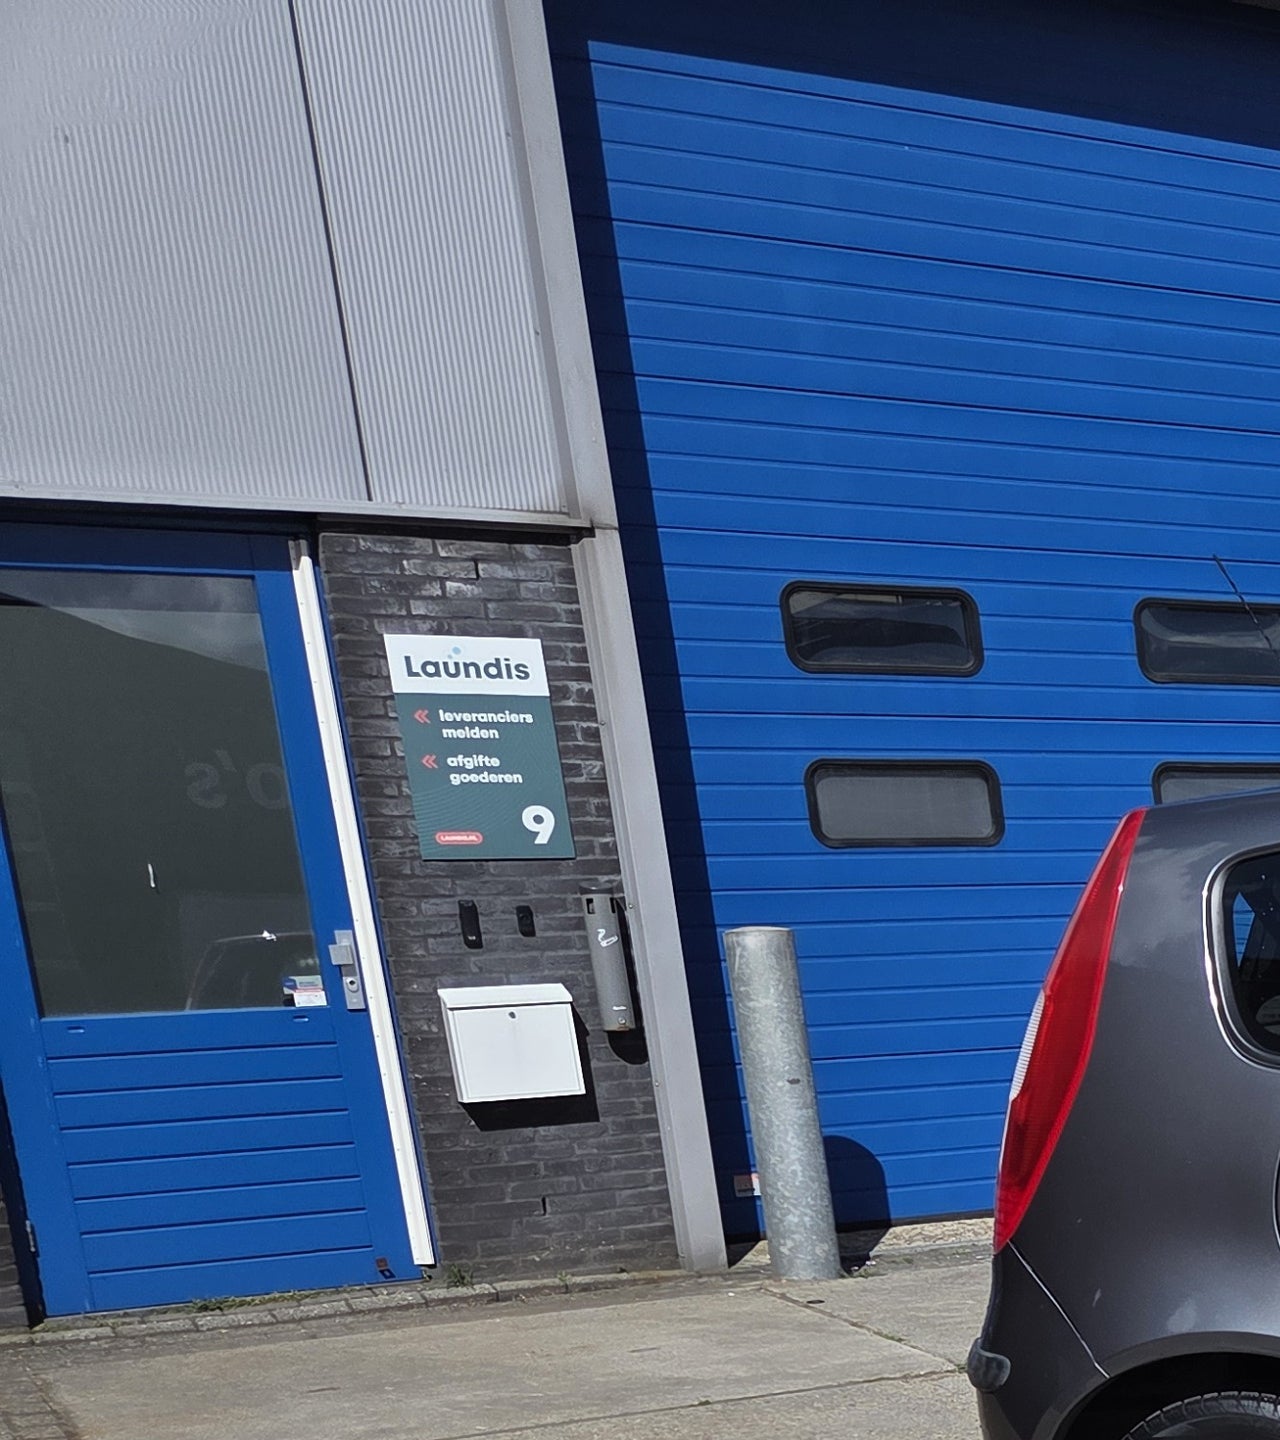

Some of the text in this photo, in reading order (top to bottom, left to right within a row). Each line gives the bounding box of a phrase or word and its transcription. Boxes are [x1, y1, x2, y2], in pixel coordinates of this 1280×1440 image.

[404, 655, 531, 681] Laundis
[438, 709, 534, 723] leveranciers
[442, 726, 500, 739] melden
[446, 754, 501, 769] afgifte
[449, 771, 523, 786] goederen
[521, 805, 555, 844] 9
